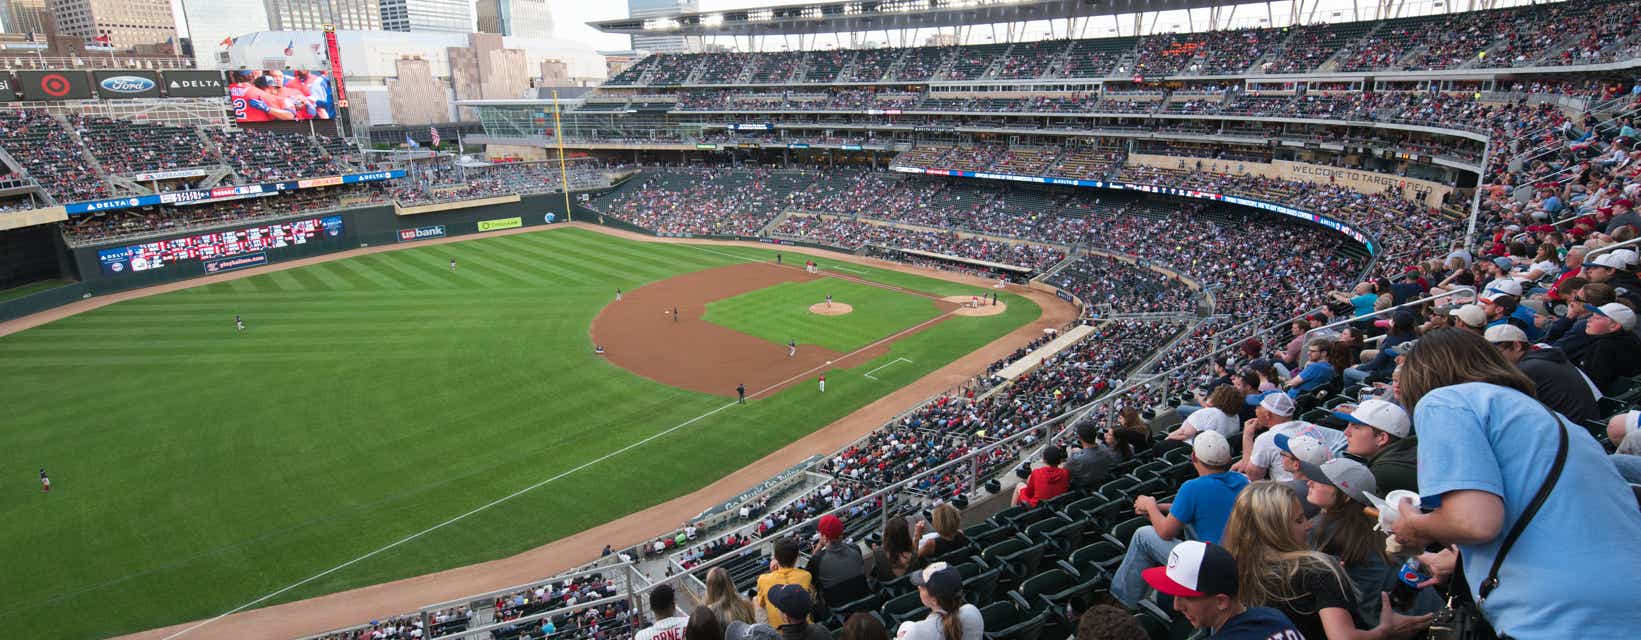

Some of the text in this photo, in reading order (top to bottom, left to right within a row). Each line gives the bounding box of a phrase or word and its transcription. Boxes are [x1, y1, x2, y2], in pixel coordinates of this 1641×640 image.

[112, 77, 144, 90] Ford
[182, 79, 221, 88] DELTA
[1293, 166, 1433, 194] WELCOME TO TARGET FIELD
[96, 201, 127, 209] DELTA
